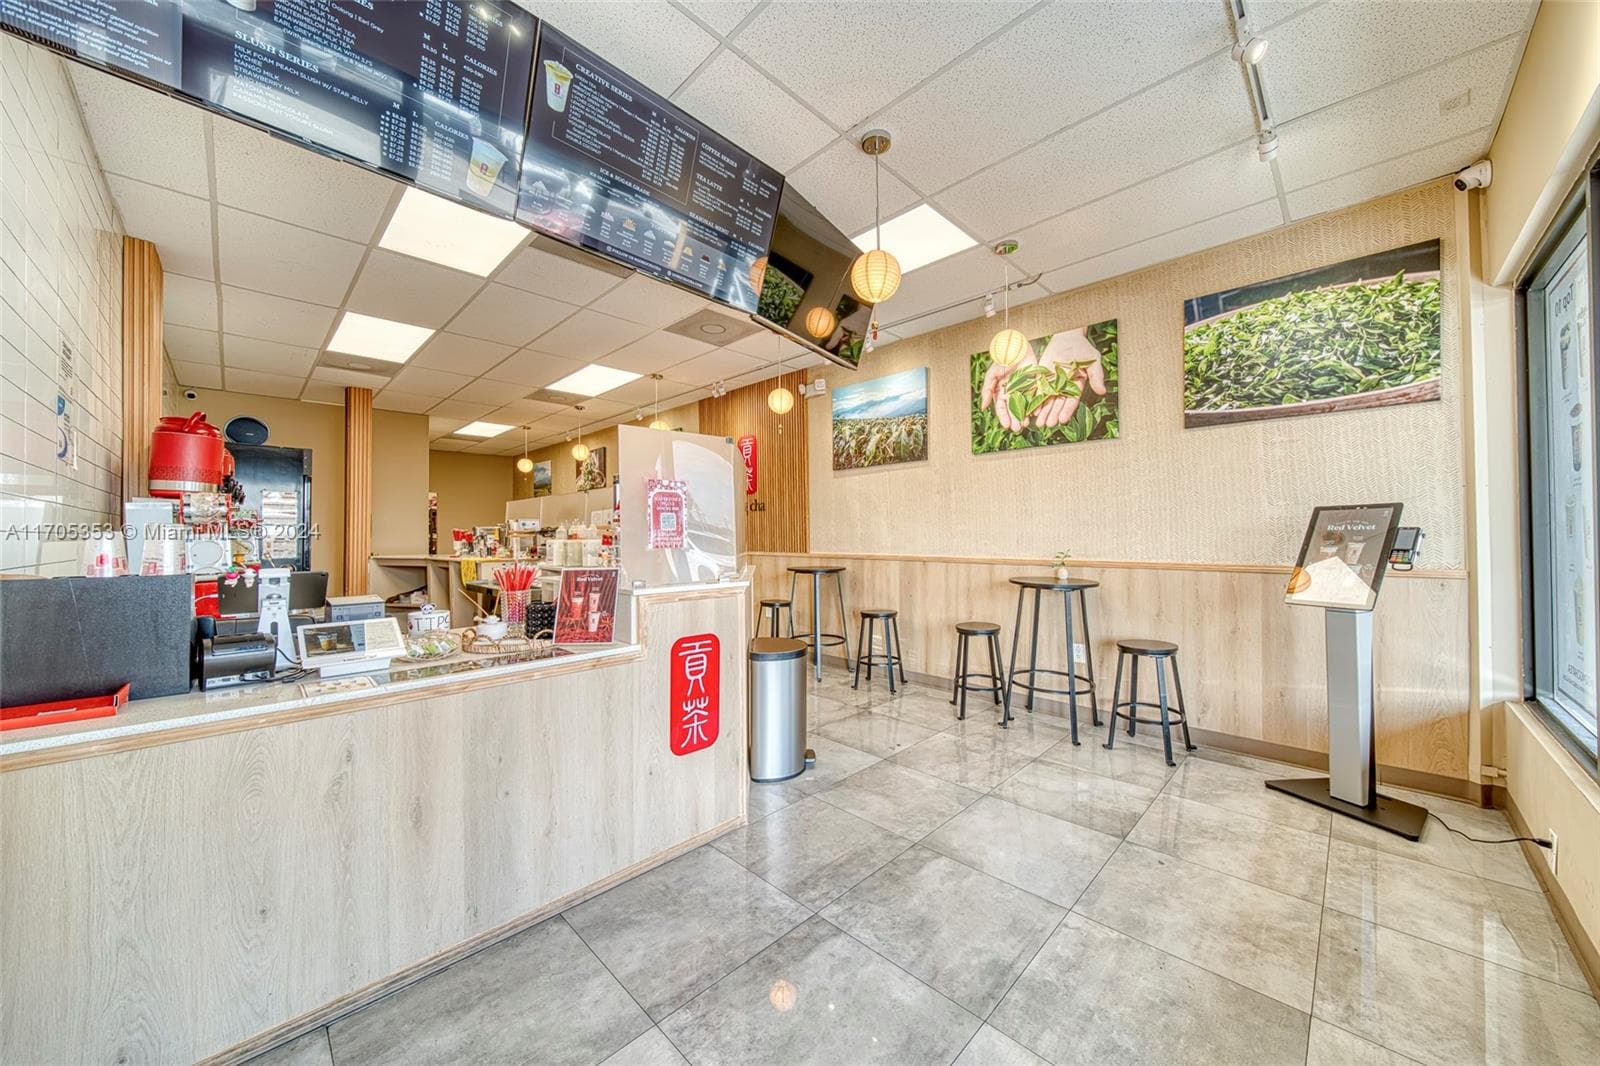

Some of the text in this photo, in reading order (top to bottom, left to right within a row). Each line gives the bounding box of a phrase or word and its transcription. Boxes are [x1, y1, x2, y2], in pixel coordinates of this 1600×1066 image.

[234, 29, 319, 73] SLUSH SERIES
[234, 51, 262, 66] LYCHEE
[422, 33, 431, 41] M
[463, 54, 498, 75] CALORIES
[233, 58, 279, 81] MANGO MILK
[233, 65, 300, 96] STRAWBERRY MILK
[234, 44, 252, 56] MILK
[252, 52, 274, 65] FOAM
[275, 62, 299, 75] PEACH
[299, 73, 320, 85] SLUSH
[332, 87, 349, 98] STAR
[349, 95, 368, 106] JELLY
[575, 63, 632, 102] CREATIVE SERIES
[434, 121, 469, 139] CALORIES
[750, 499, 766, 511] cha
[1347, 523, 1376, 531] Velvet
[678, 639, 713, 748] 貢茶
